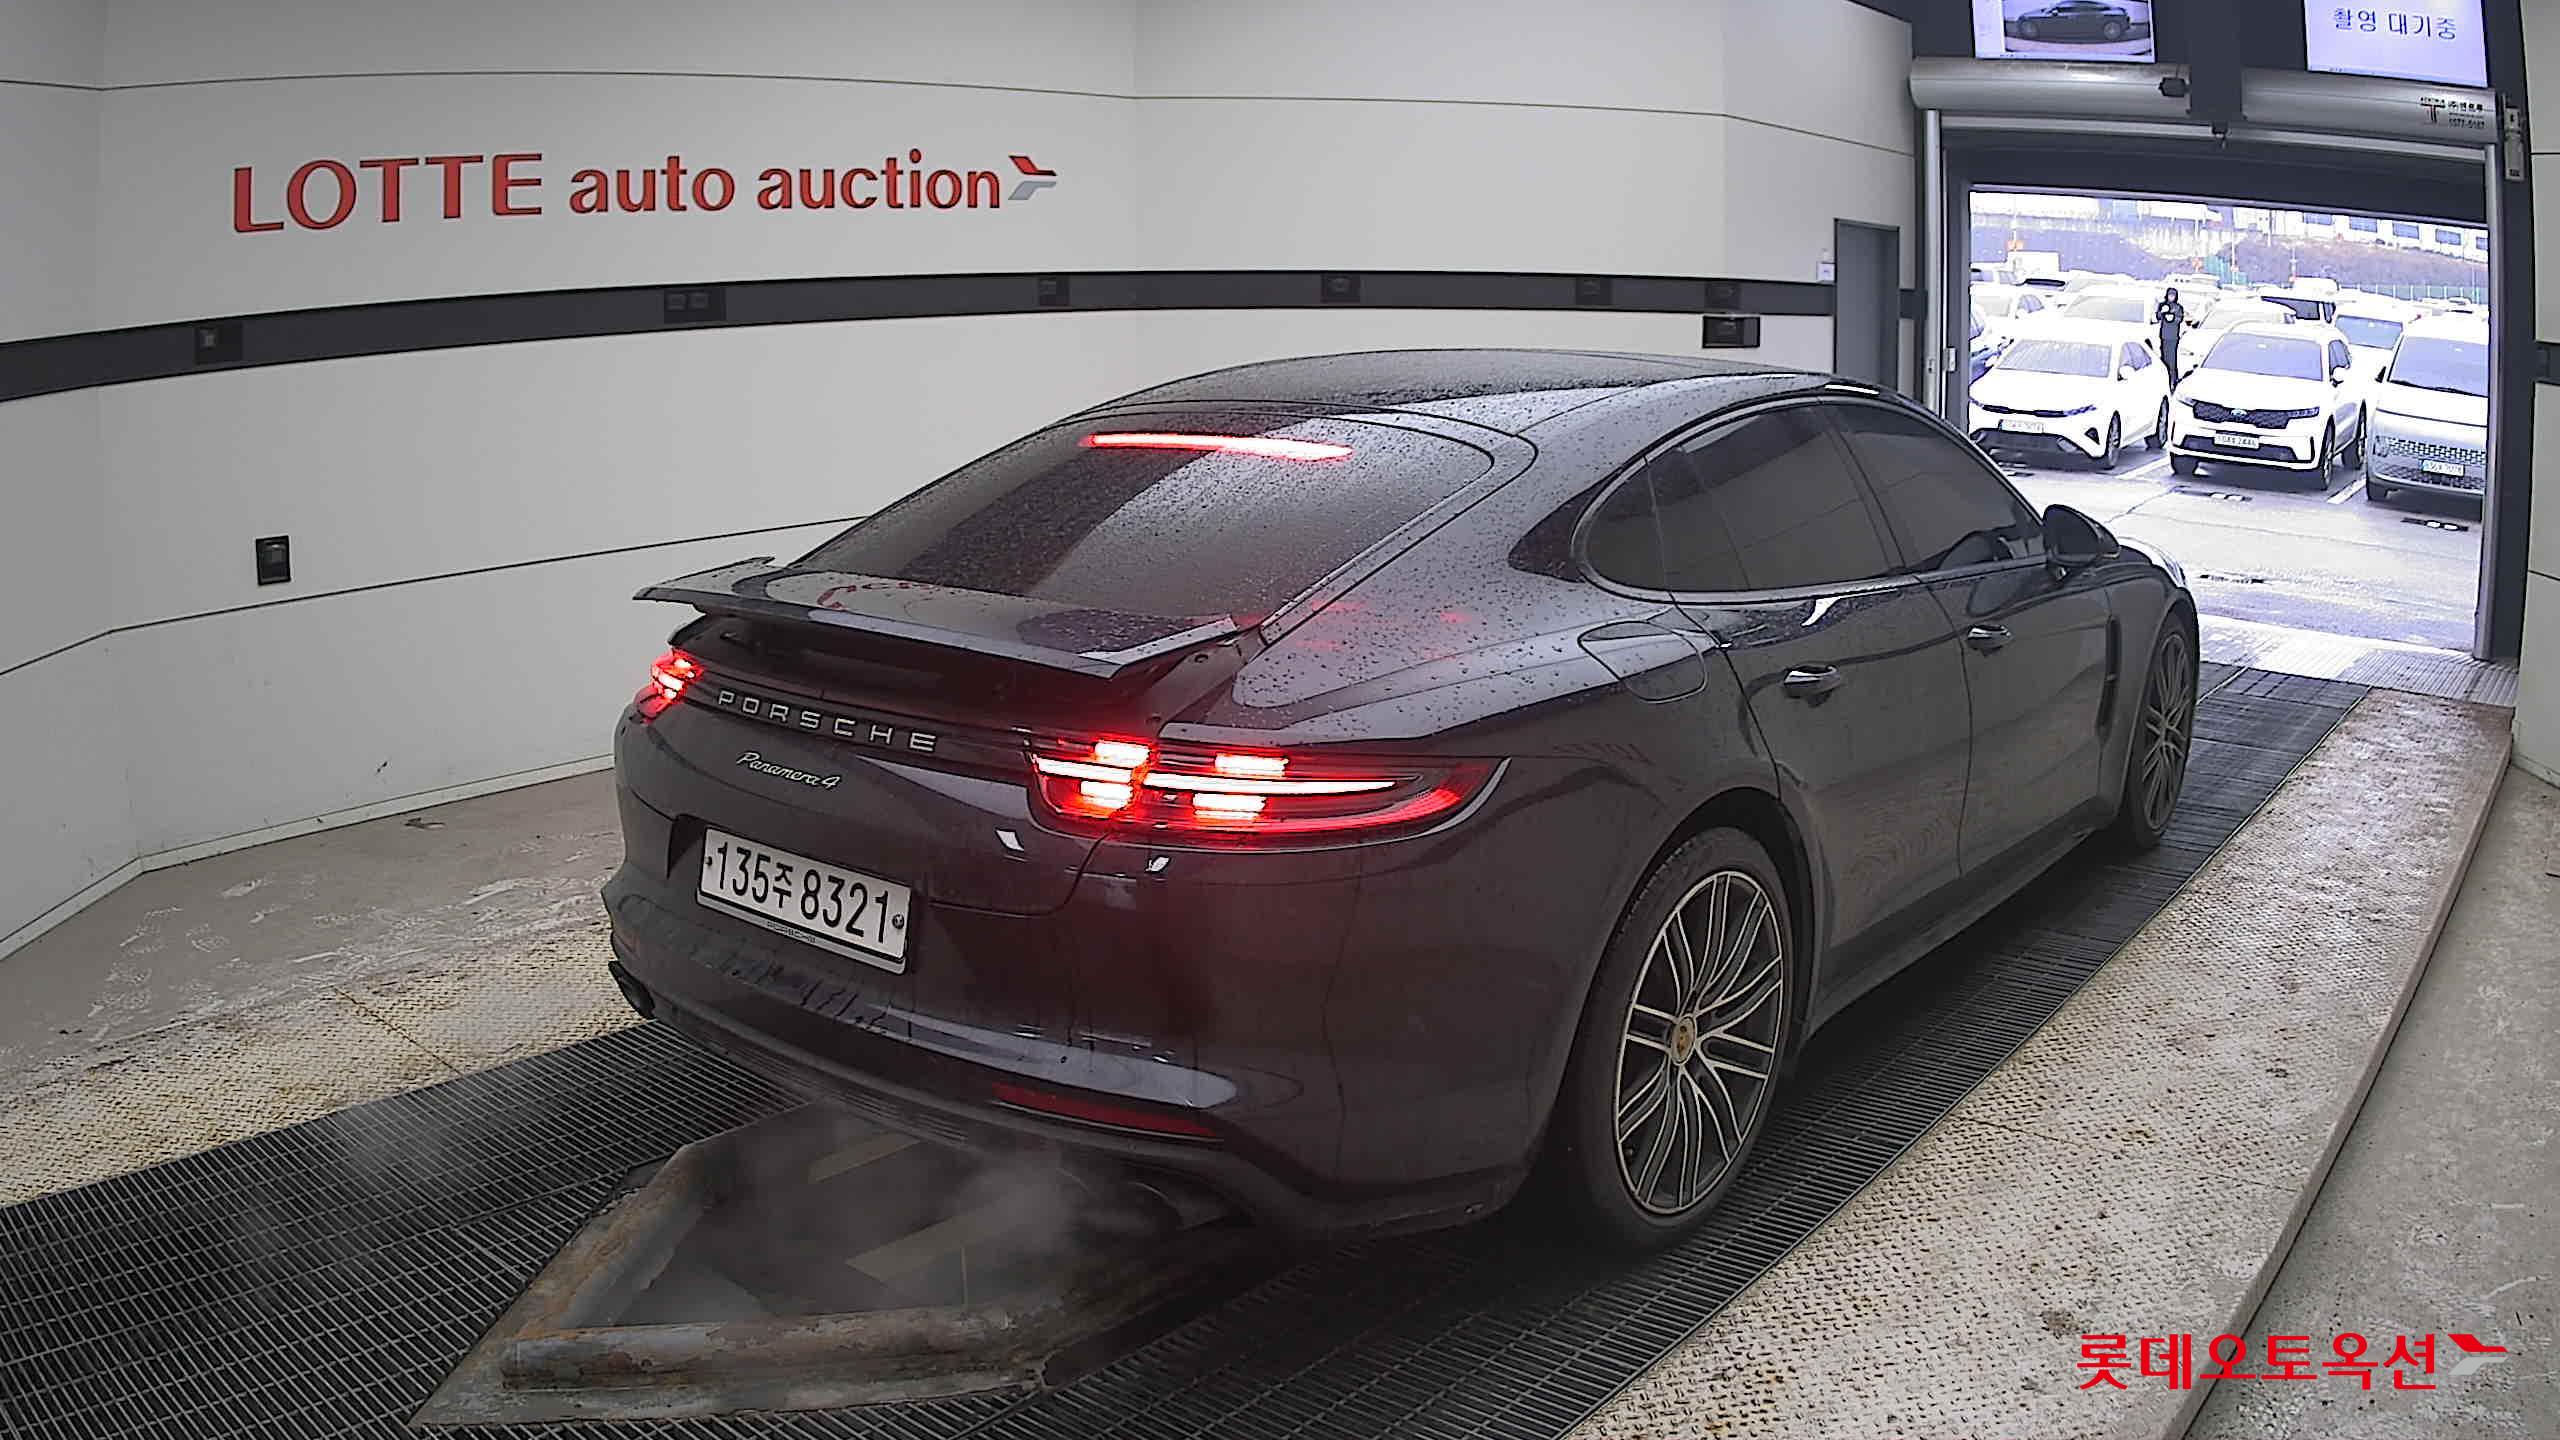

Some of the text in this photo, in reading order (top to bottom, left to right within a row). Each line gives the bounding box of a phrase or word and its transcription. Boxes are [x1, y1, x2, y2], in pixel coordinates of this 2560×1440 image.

[2334, 7, 2457, 40] 촬영 대기중
[234, 148, 1001, 233] LOTTE auto auction
[718, 689, 936, 752] PORSCHE
[736, 751, 841, 790] Panamera 4
